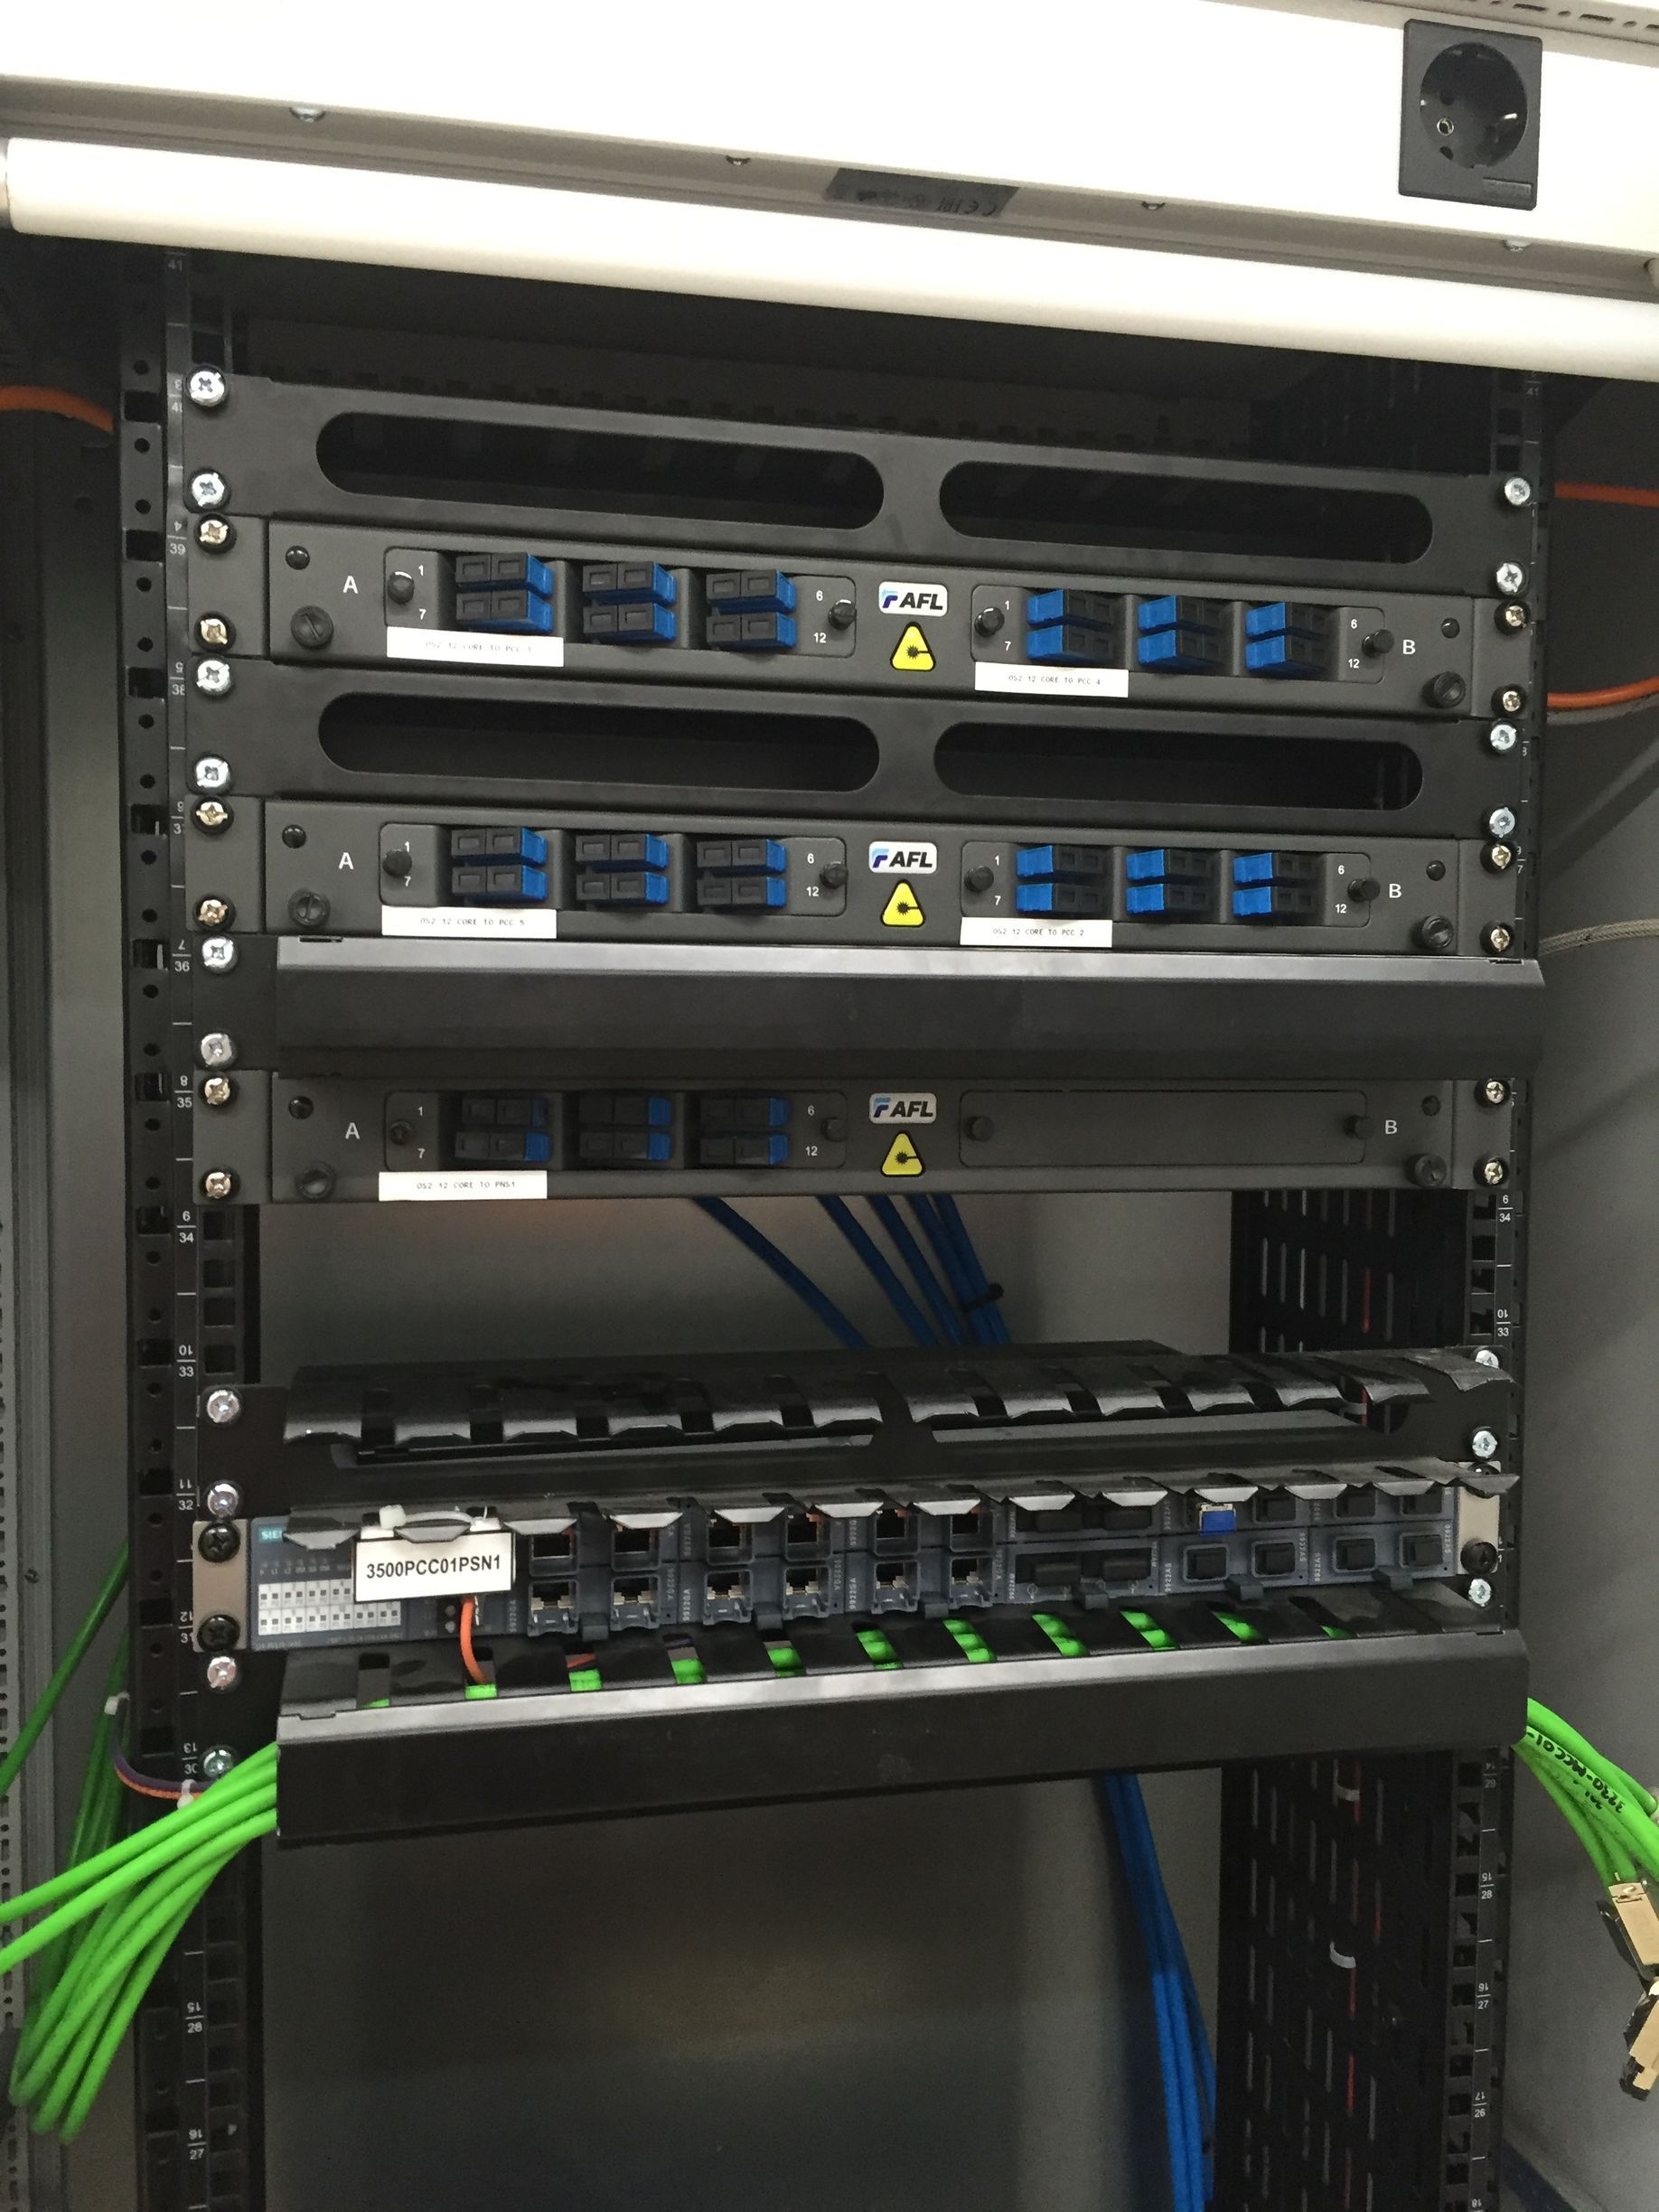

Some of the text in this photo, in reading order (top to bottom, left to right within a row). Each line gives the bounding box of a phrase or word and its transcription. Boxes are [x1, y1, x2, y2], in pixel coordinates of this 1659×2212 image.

[170, 543, 187, 556] 39
[417, 565, 424, 576] 1
[342, 576, 359, 595] A
[815, 589, 824, 601] 6
[899, 592, 943, 610] AFL
[1004, 600, 1010, 611] 1
[419, 609, 426, 620] 7
[1350, 619, 1357, 629] 6
[813, 632, 826, 643] 12
[1004, 642, 1011, 651] 7
[1401, 639, 1415, 655] B
[1347, 658, 1360, 669] 12
[1077, 677, 1091, 685] PCC
[404, 841, 410, 852] 1
[339, 852, 354, 870] A
[807, 853, 814, 864] 6
[889, 850, 933, 868] AFL
[994, 855, 999, 867] 1
[1337, 864, 1344, 875] 6
[404, 876, 411, 887] 7
[806, 886, 820, 897] 12
[1389, 883, 1402, 899] B
[994, 895, 1000, 906] 7
[1334, 904, 1346, 914] 12
[1025, 928, 1044, 936] CORE
[174, 961, 191, 973] 36
[180, 1075, 189, 1087] 8
[176, 1097, 192, 1109] 35
[418, 1106, 424, 1116] 1
[807, 1105, 815, 1116] 6
[889, 1101, 933, 1118] AFL
[345, 1122, 361, 1139] A
[1384, 1119, 1398, 1135] B
[417, 1148, 426, 1158] 7
[805, 1146, 819, 1158] 12
[454, 1181, 473, 1189] CORE
[495, 1180, 515, 1188] PNS1
[1499, 1213, 1511, 1223] 34
[179, 1233, 195, 1244] 34
[1497, 1327, 1509, 1337] 33
[178, 1366, 194, 1377] 33
[178, 1500, 193, 1511] 32
[366, 1554, 501, 1579] 3500PCC01PSN1
[1481, 1889, 1493, 1899] 28
[1477, 2000, 1489, 2010] 27
[187, 2022, 202, 2034] 28
[1474, 2108, 1486, 2118] 26
[190, 2148, 204, 2160] 27
